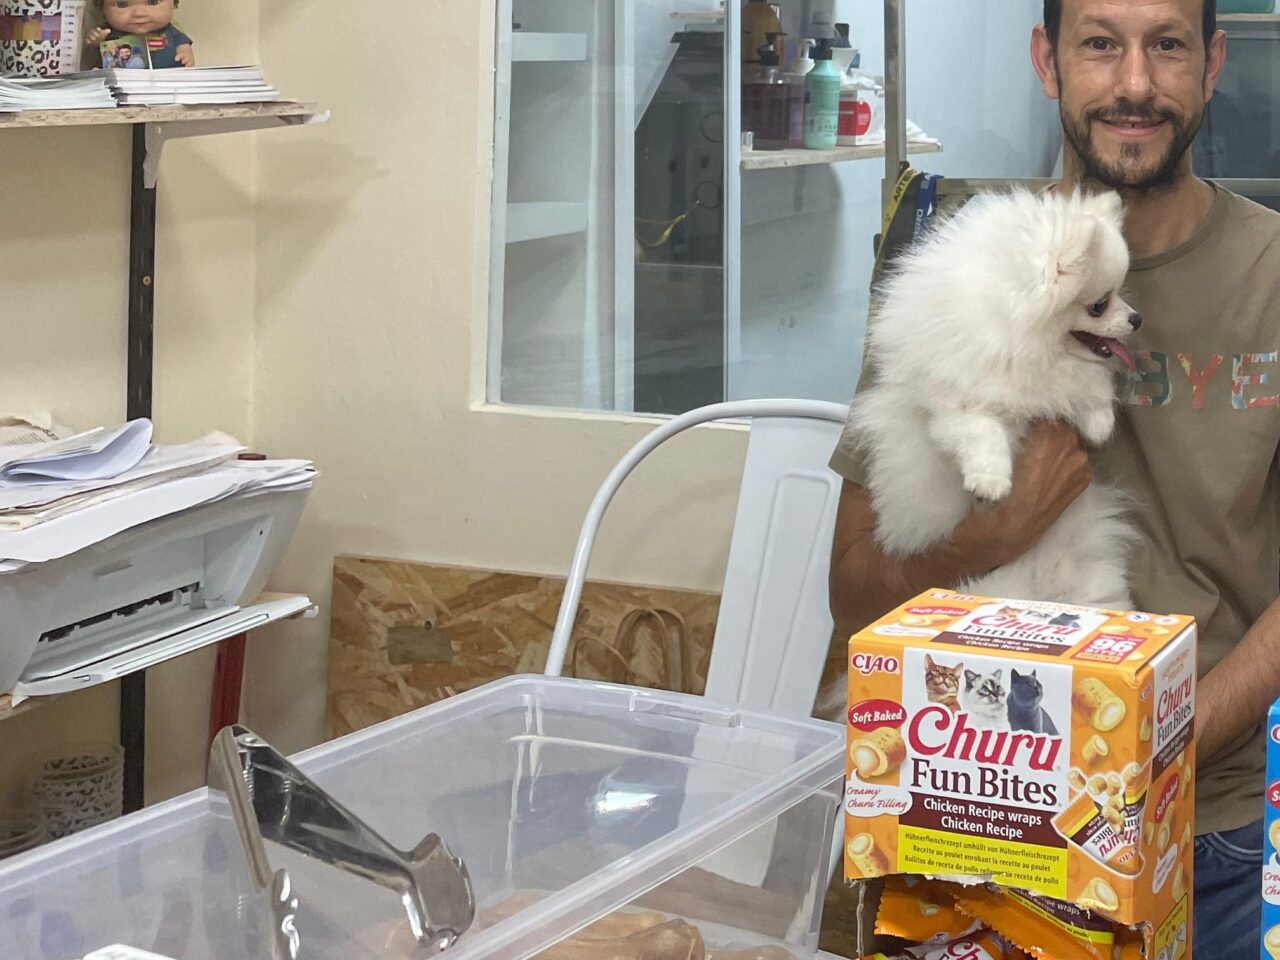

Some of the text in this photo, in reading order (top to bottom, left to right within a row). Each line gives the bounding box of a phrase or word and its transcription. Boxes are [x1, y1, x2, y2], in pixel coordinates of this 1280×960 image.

[963, 625, 1066, 643] Fun Bites
[971, 615, 1081, 636] Churu
[1090, 638, 1137, 653] 96
[852, 655, 898, 674] CIAO
[1157, 674, 1193, 725] Churu
[853, 709, 903, 723] Soft Baked
[908, 706, 1063, 772] Churu
[911, 758, 1058, 807] Fun Bites
[847, 787, 881, 801] Creamy
[847, 799, 908, 811] Churu Filling
[924, 798, 1042, 827] Chicken Recipe wraps
[941, 816, 1023, 840] Chicken Recipe
[913, 845, 1051, 873] Recette poulet enrobant recette poulet
[936, 861, 1060, 885] receta pollo receta de pollo
[1057, 903, 1080, 916] wraps
